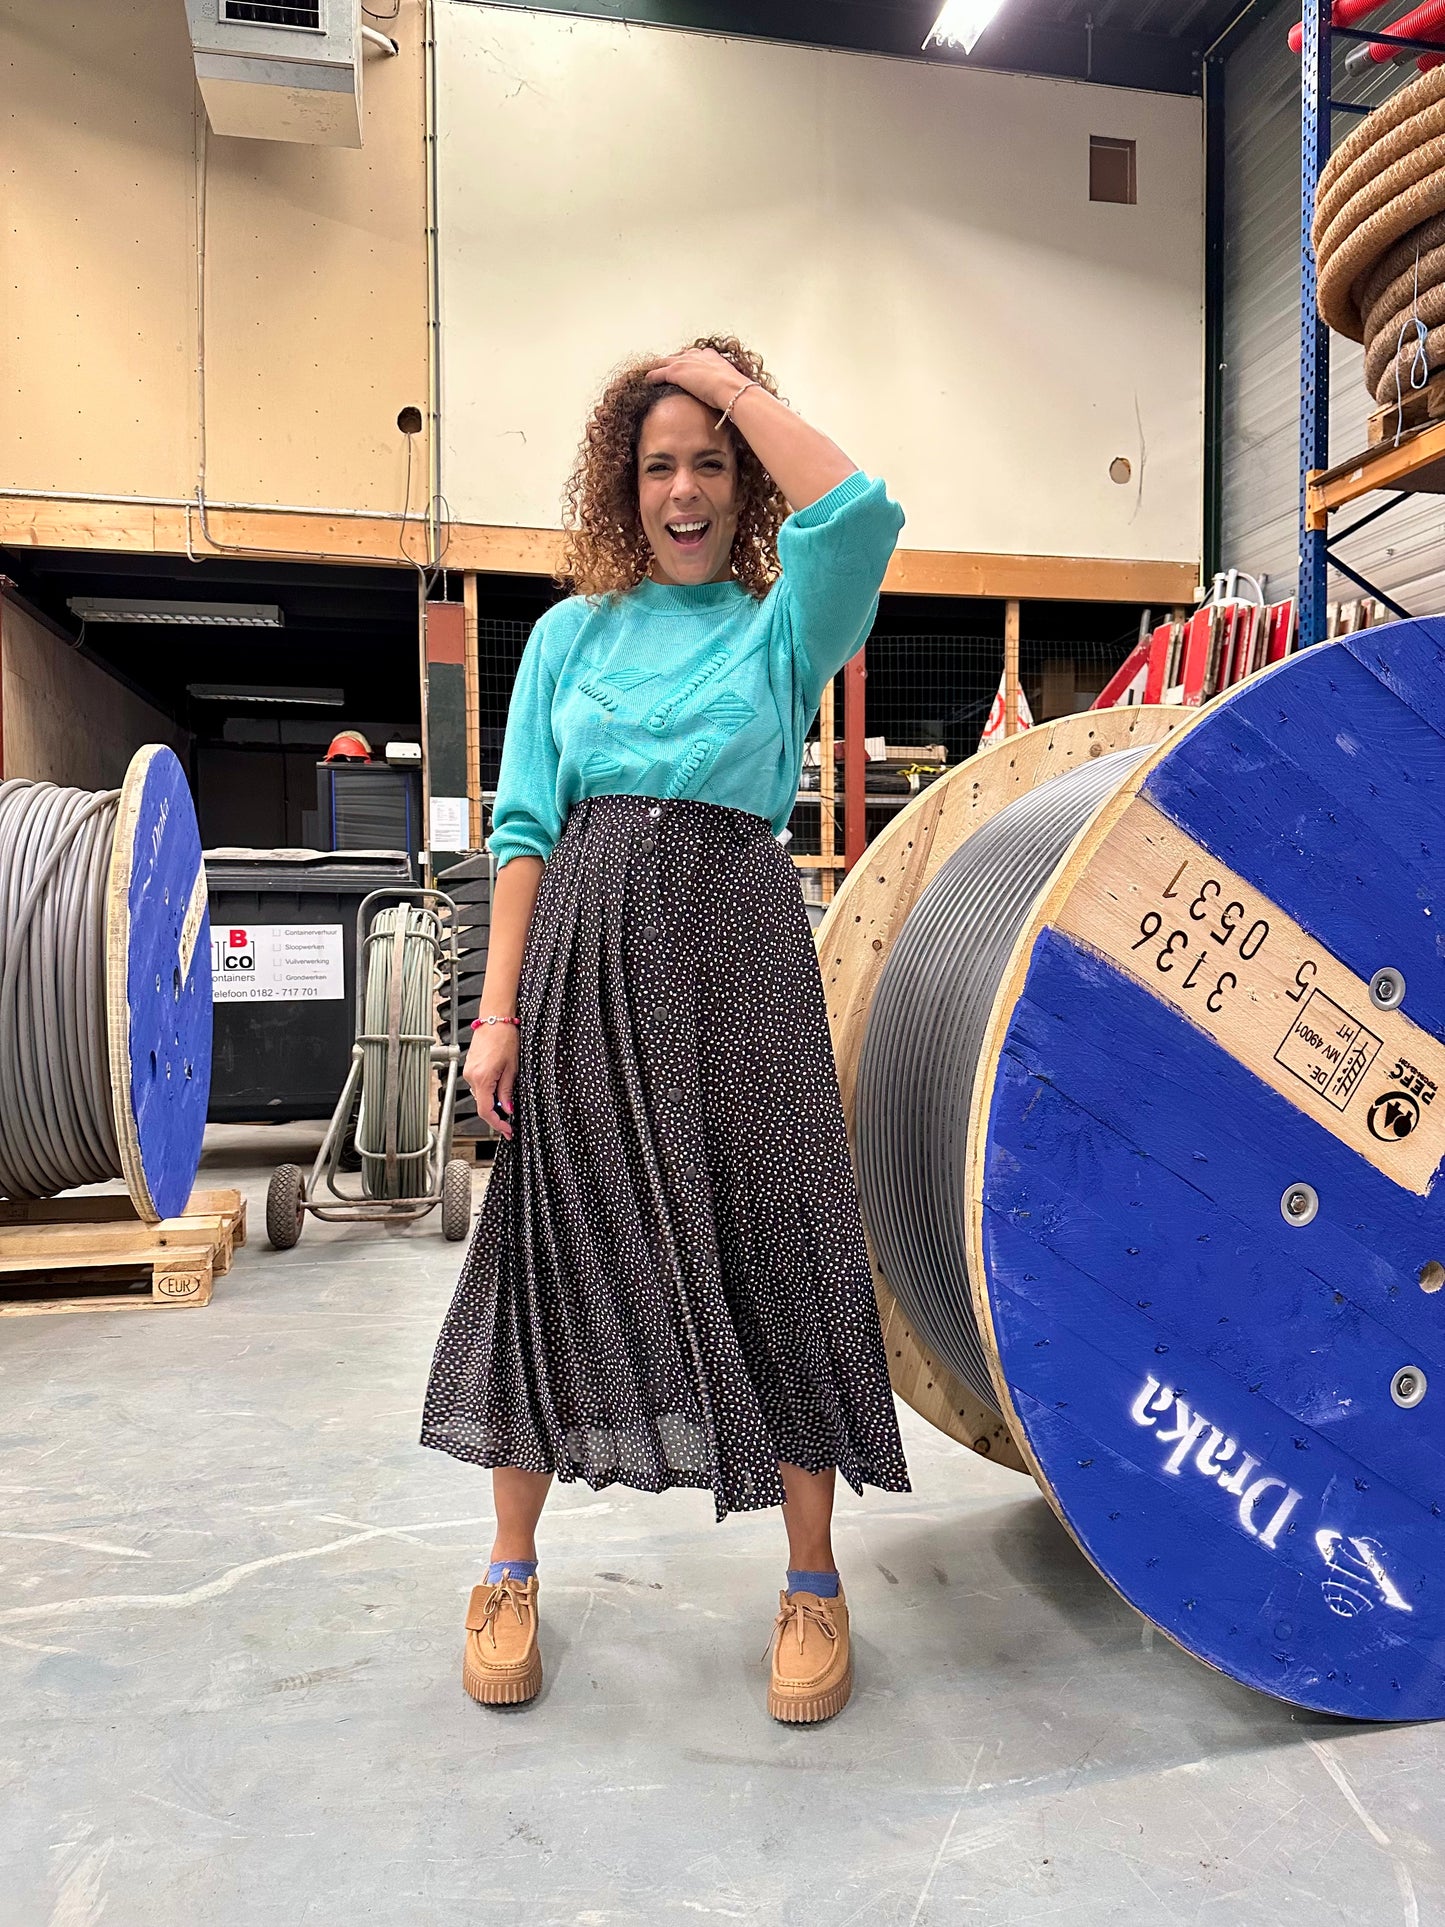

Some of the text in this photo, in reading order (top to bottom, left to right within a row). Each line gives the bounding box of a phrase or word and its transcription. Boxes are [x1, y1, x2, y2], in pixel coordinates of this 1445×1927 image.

[229, 929, 248, 948] B
[1162, 860, 1317, 1002] 5 0531
[285, 943, 325, 951] Sloopwerken
[1131, 911, 1237, 1012] 3136
[212, 974, 256, 983] ontainers
[212, 989, 248, 998] elefoon
[250, 988, 273, 997] 0182
[281, 988, 299, 997] 717
[301, 987, 318, 996] 701
[1335, 1023, 1355, 1042] HT
[1294, 1021, 1341, 1064] MV 49001
[1390, 1063, 1436, 1106] PEFC
[168, 1278, 191, 1293] EUR
[1131, 1375, 1303, 1549] Draka
